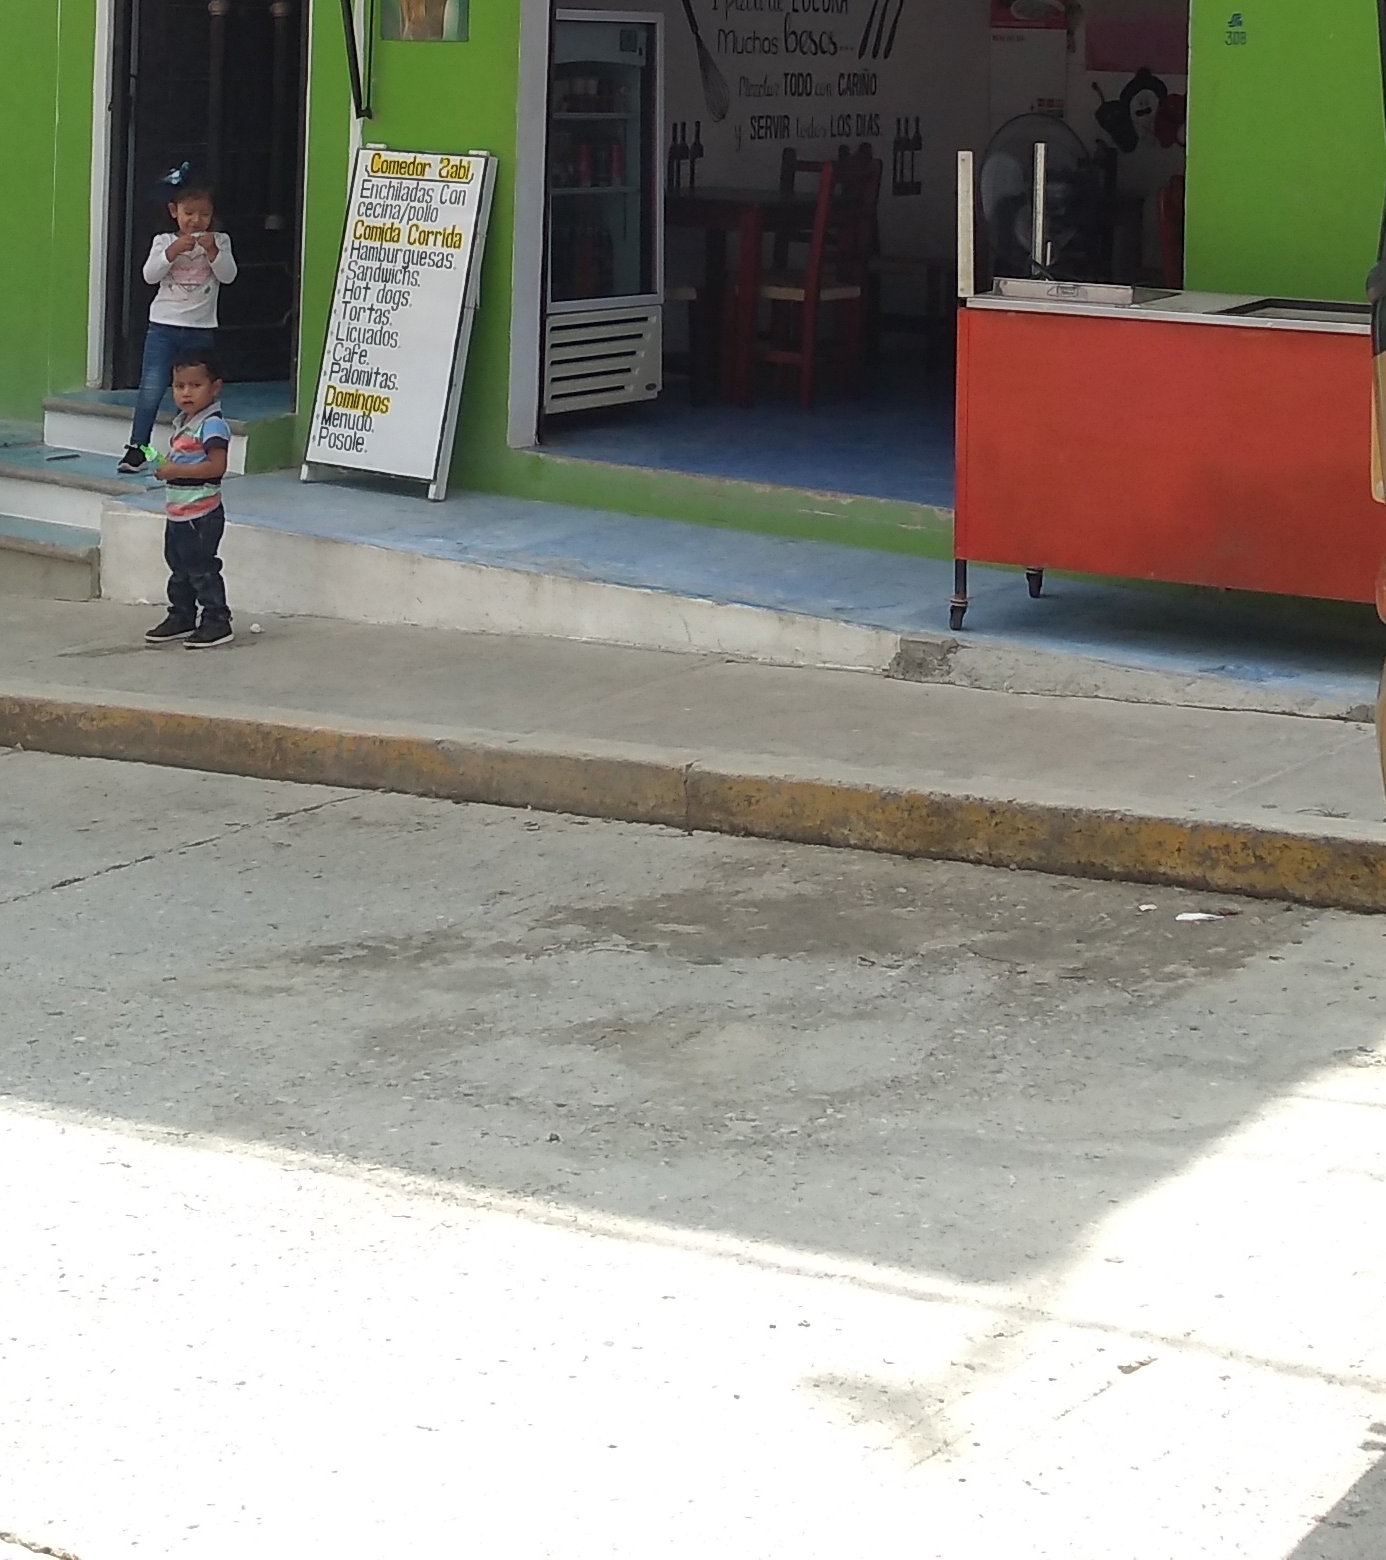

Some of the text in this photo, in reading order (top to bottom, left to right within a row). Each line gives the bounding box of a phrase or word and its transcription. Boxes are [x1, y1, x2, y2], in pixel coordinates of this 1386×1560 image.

[718, 29, 778, 55] Muchos
[783, 73, 812, 96] TODO
[838, 68, 877, 96] CARIÑO
[750, 115, 790, 139] SERVIR
[830, 114, 851, 137] LOS
[370, 152, 471, 180] Comedor Sabi
[360, 179, 467, 206] Enchiladas Con
[357, 201, 439, 225] cecina/pollo
[353, 219, 462, 249] Comida Corrida
[346, 260, 420, 287] Sandwichs.
[342, 280, 371, 302] Hot
[328, 362, 399, 390] Palomitas.
[324, 385, 390, 417] Domingos
